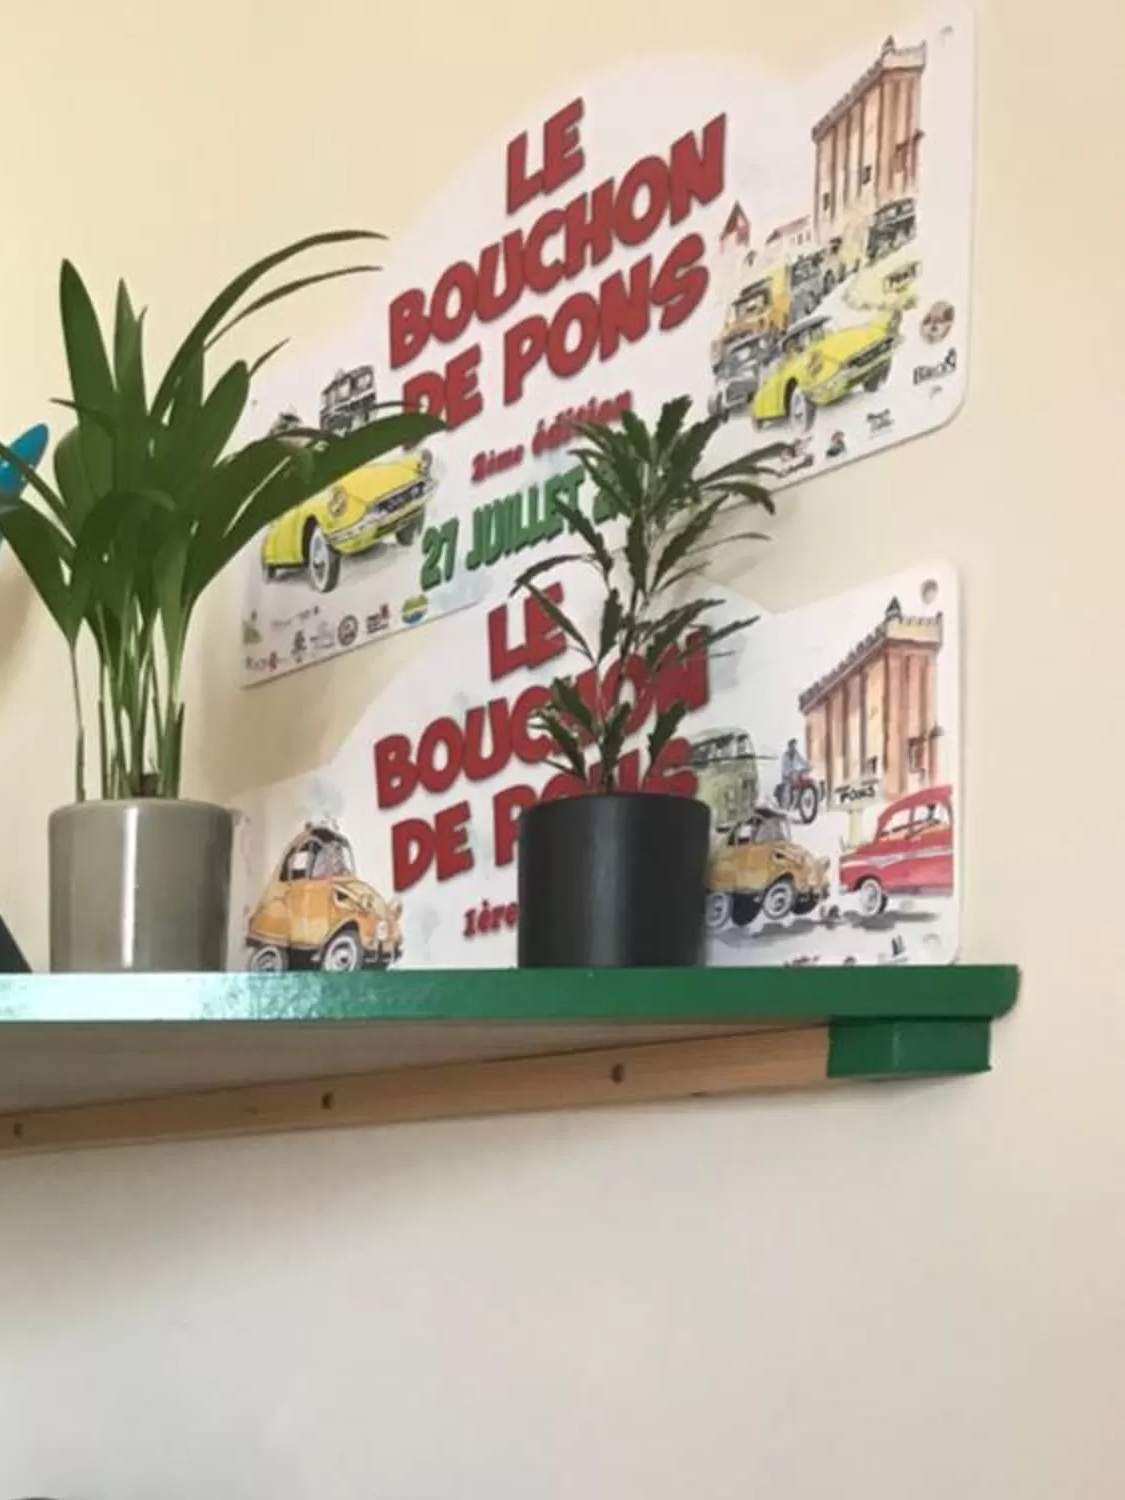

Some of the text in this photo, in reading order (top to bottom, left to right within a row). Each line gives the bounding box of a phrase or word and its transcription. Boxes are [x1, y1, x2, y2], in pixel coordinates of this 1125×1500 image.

[506, 97, 585, 216] LE
[389, 112, 727, 370] BOUCHON
[402, 233, 709, 450] DE PONS
[421, 517, 459, 591] 27
[466, 465, 585, 571] JUILLET
[487, 581, 568, 682] LE
[391, 801, 475, 893] DE
[463, 899, 519, 938] 1ère
